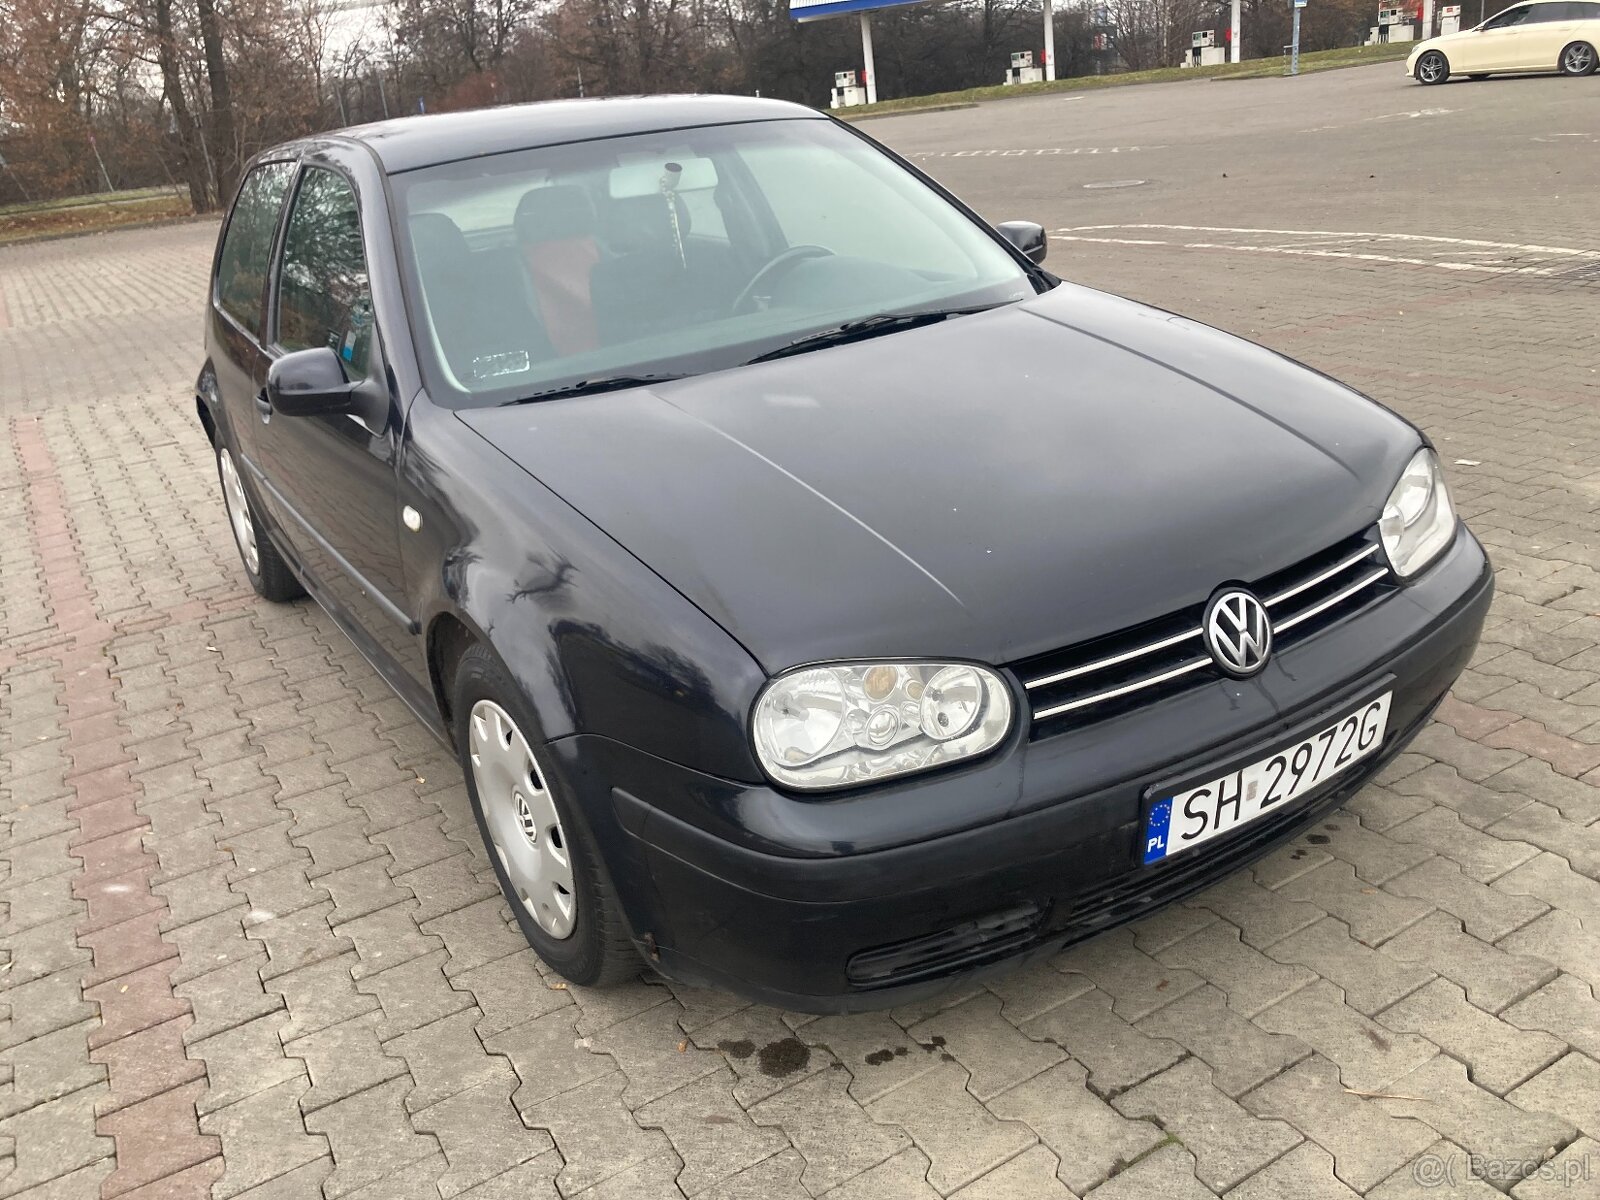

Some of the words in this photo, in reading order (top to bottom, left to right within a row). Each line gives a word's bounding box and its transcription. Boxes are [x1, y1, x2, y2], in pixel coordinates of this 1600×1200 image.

[1181, 769, 1243, 840] SH
[1259, 701, 1381, 810] 2972G
[1147, 835, 1165, 853] PL
